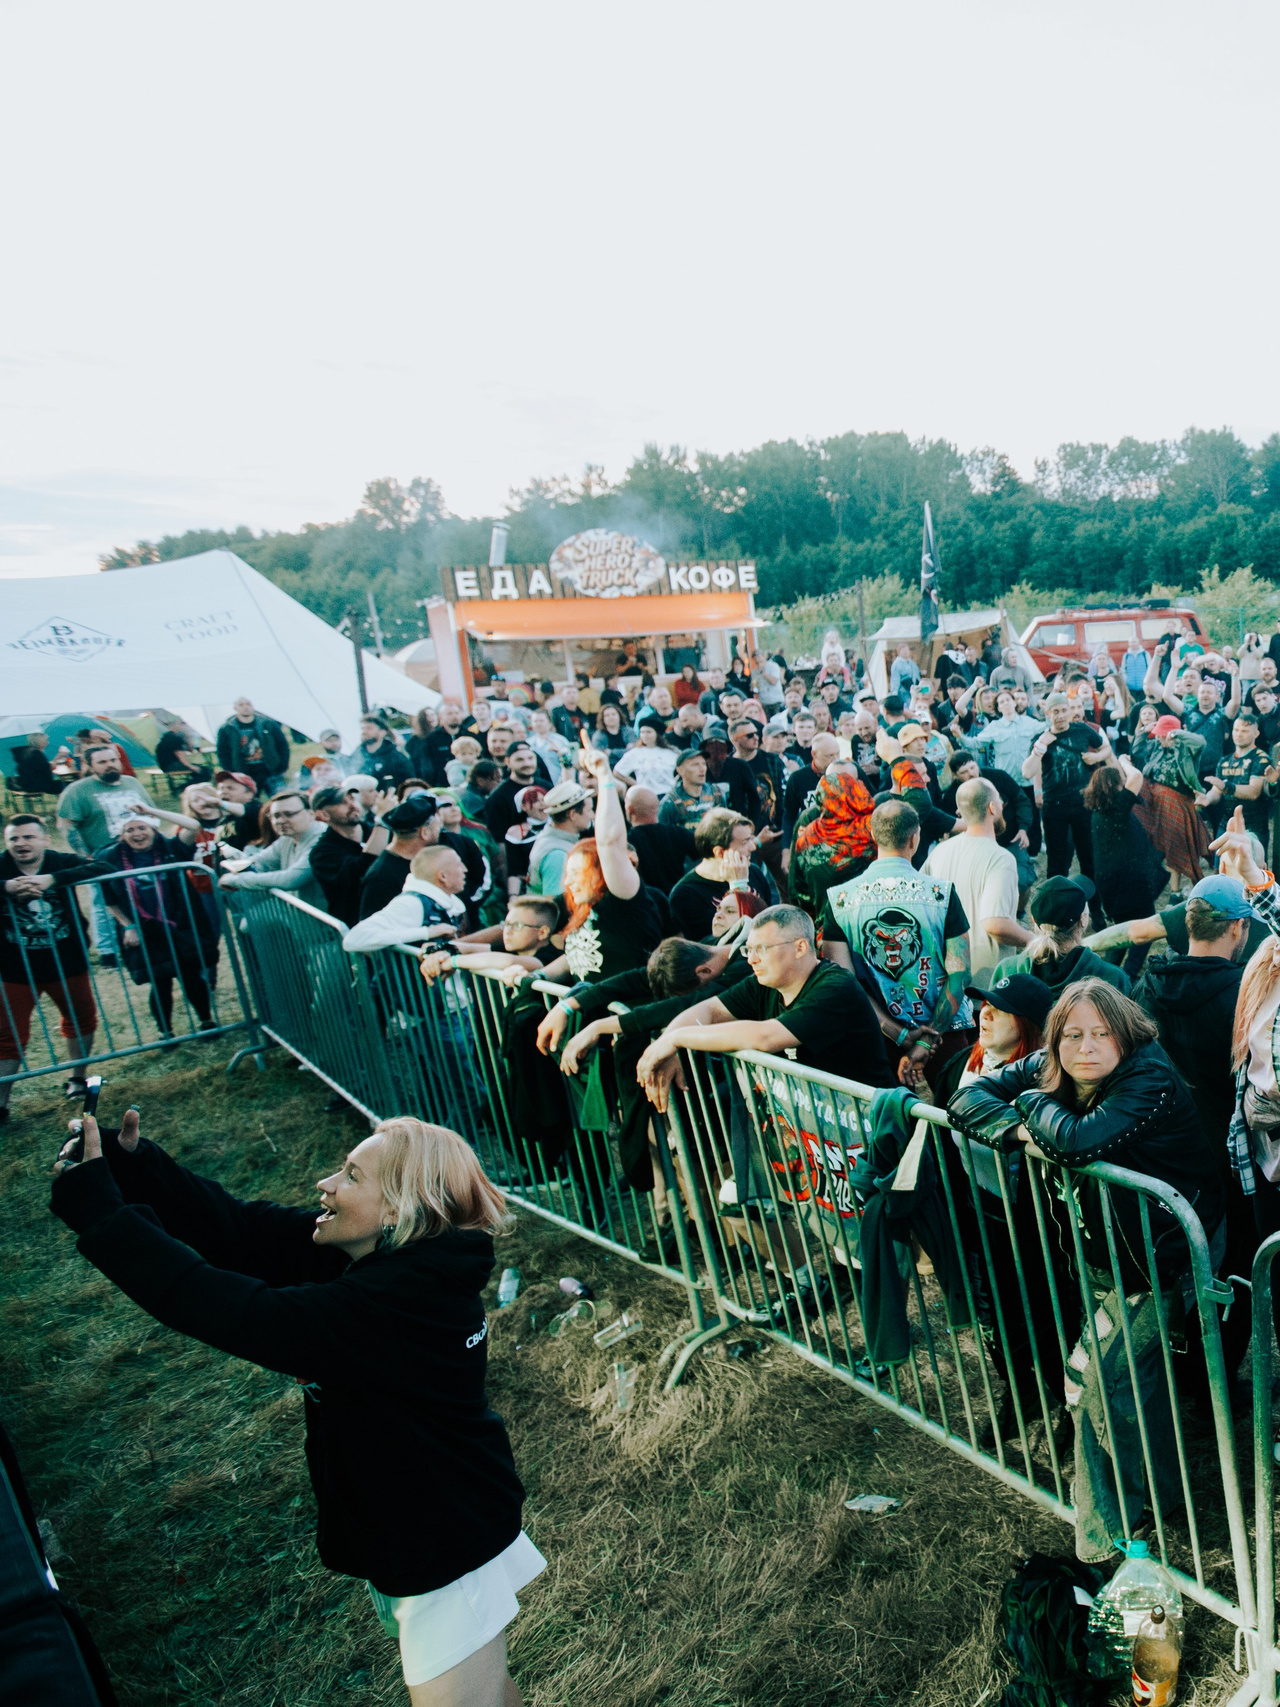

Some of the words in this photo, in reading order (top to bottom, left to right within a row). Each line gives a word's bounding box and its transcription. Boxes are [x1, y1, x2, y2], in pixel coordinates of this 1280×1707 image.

[574, 536, 635, 557] SUPER
[584, 553, 632, 571] HERO
[454, 570, 552, 600] ЕДА
[579, 567, 638, 589] TRUCK
[668, 565, 758, 591] КОФЕ
[164, 610, 235, 631] CRAFT
[176, 623, 238, 643] FOOD
[807, 1138, 865, 1171] ANT
